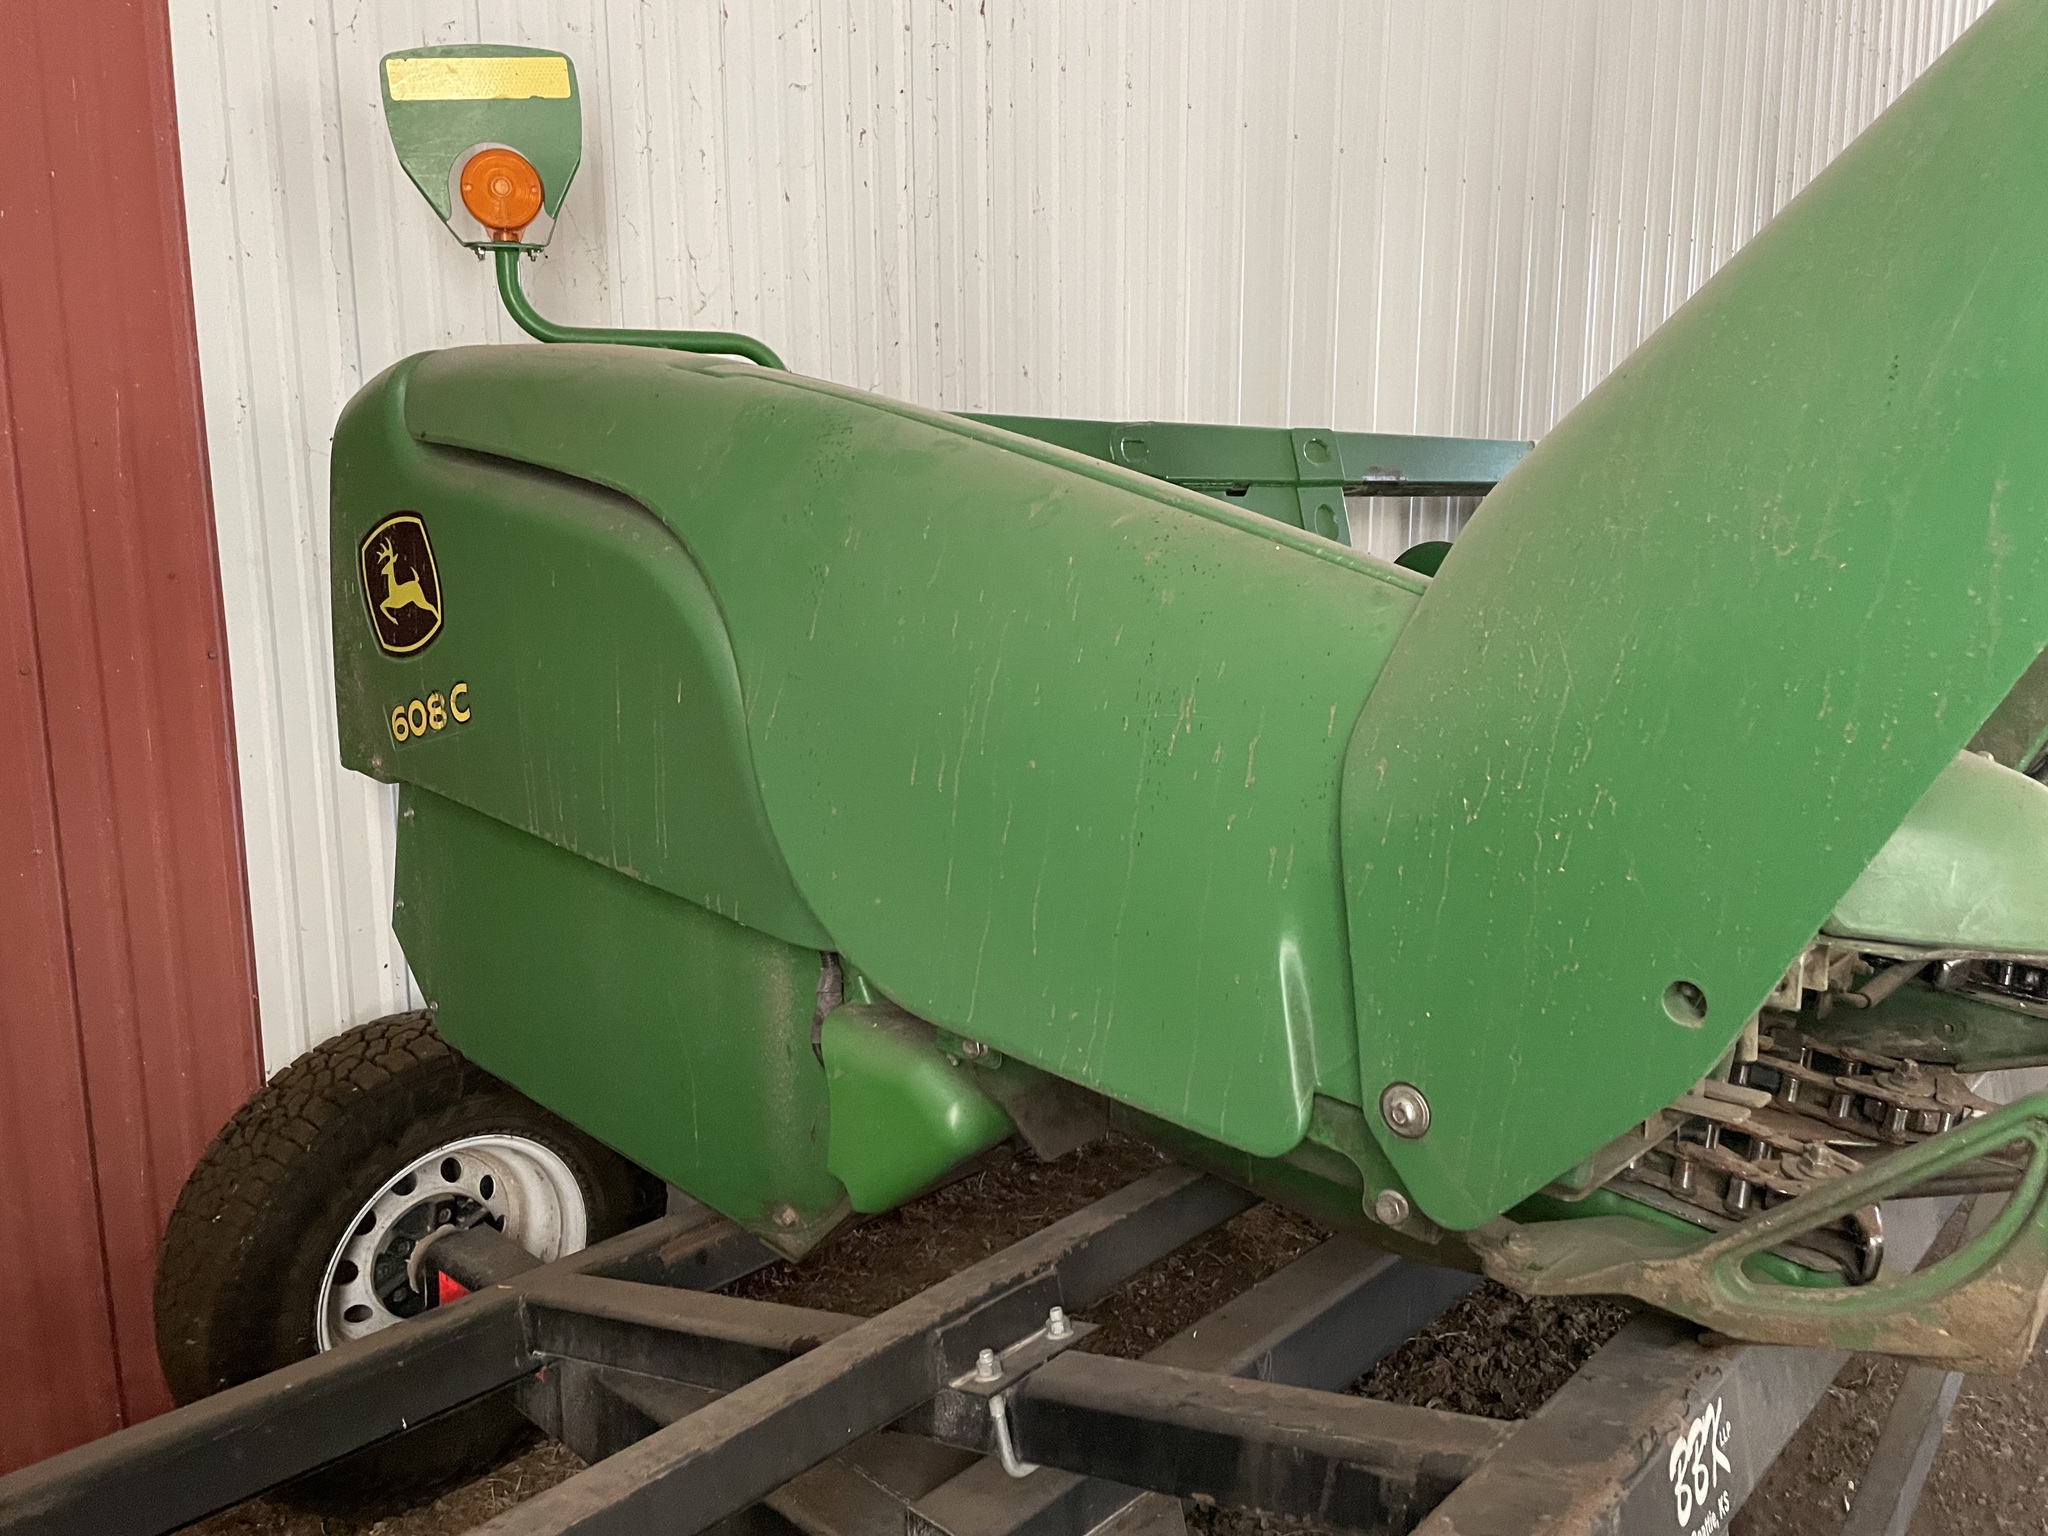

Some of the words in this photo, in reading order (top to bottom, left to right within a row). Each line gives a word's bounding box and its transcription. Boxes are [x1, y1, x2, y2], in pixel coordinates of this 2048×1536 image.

[391, 681, 471, 742] 608C
[1719, 1420, 1732, 1447] LLP
[1717, 1490, 1730, 1520] KS
